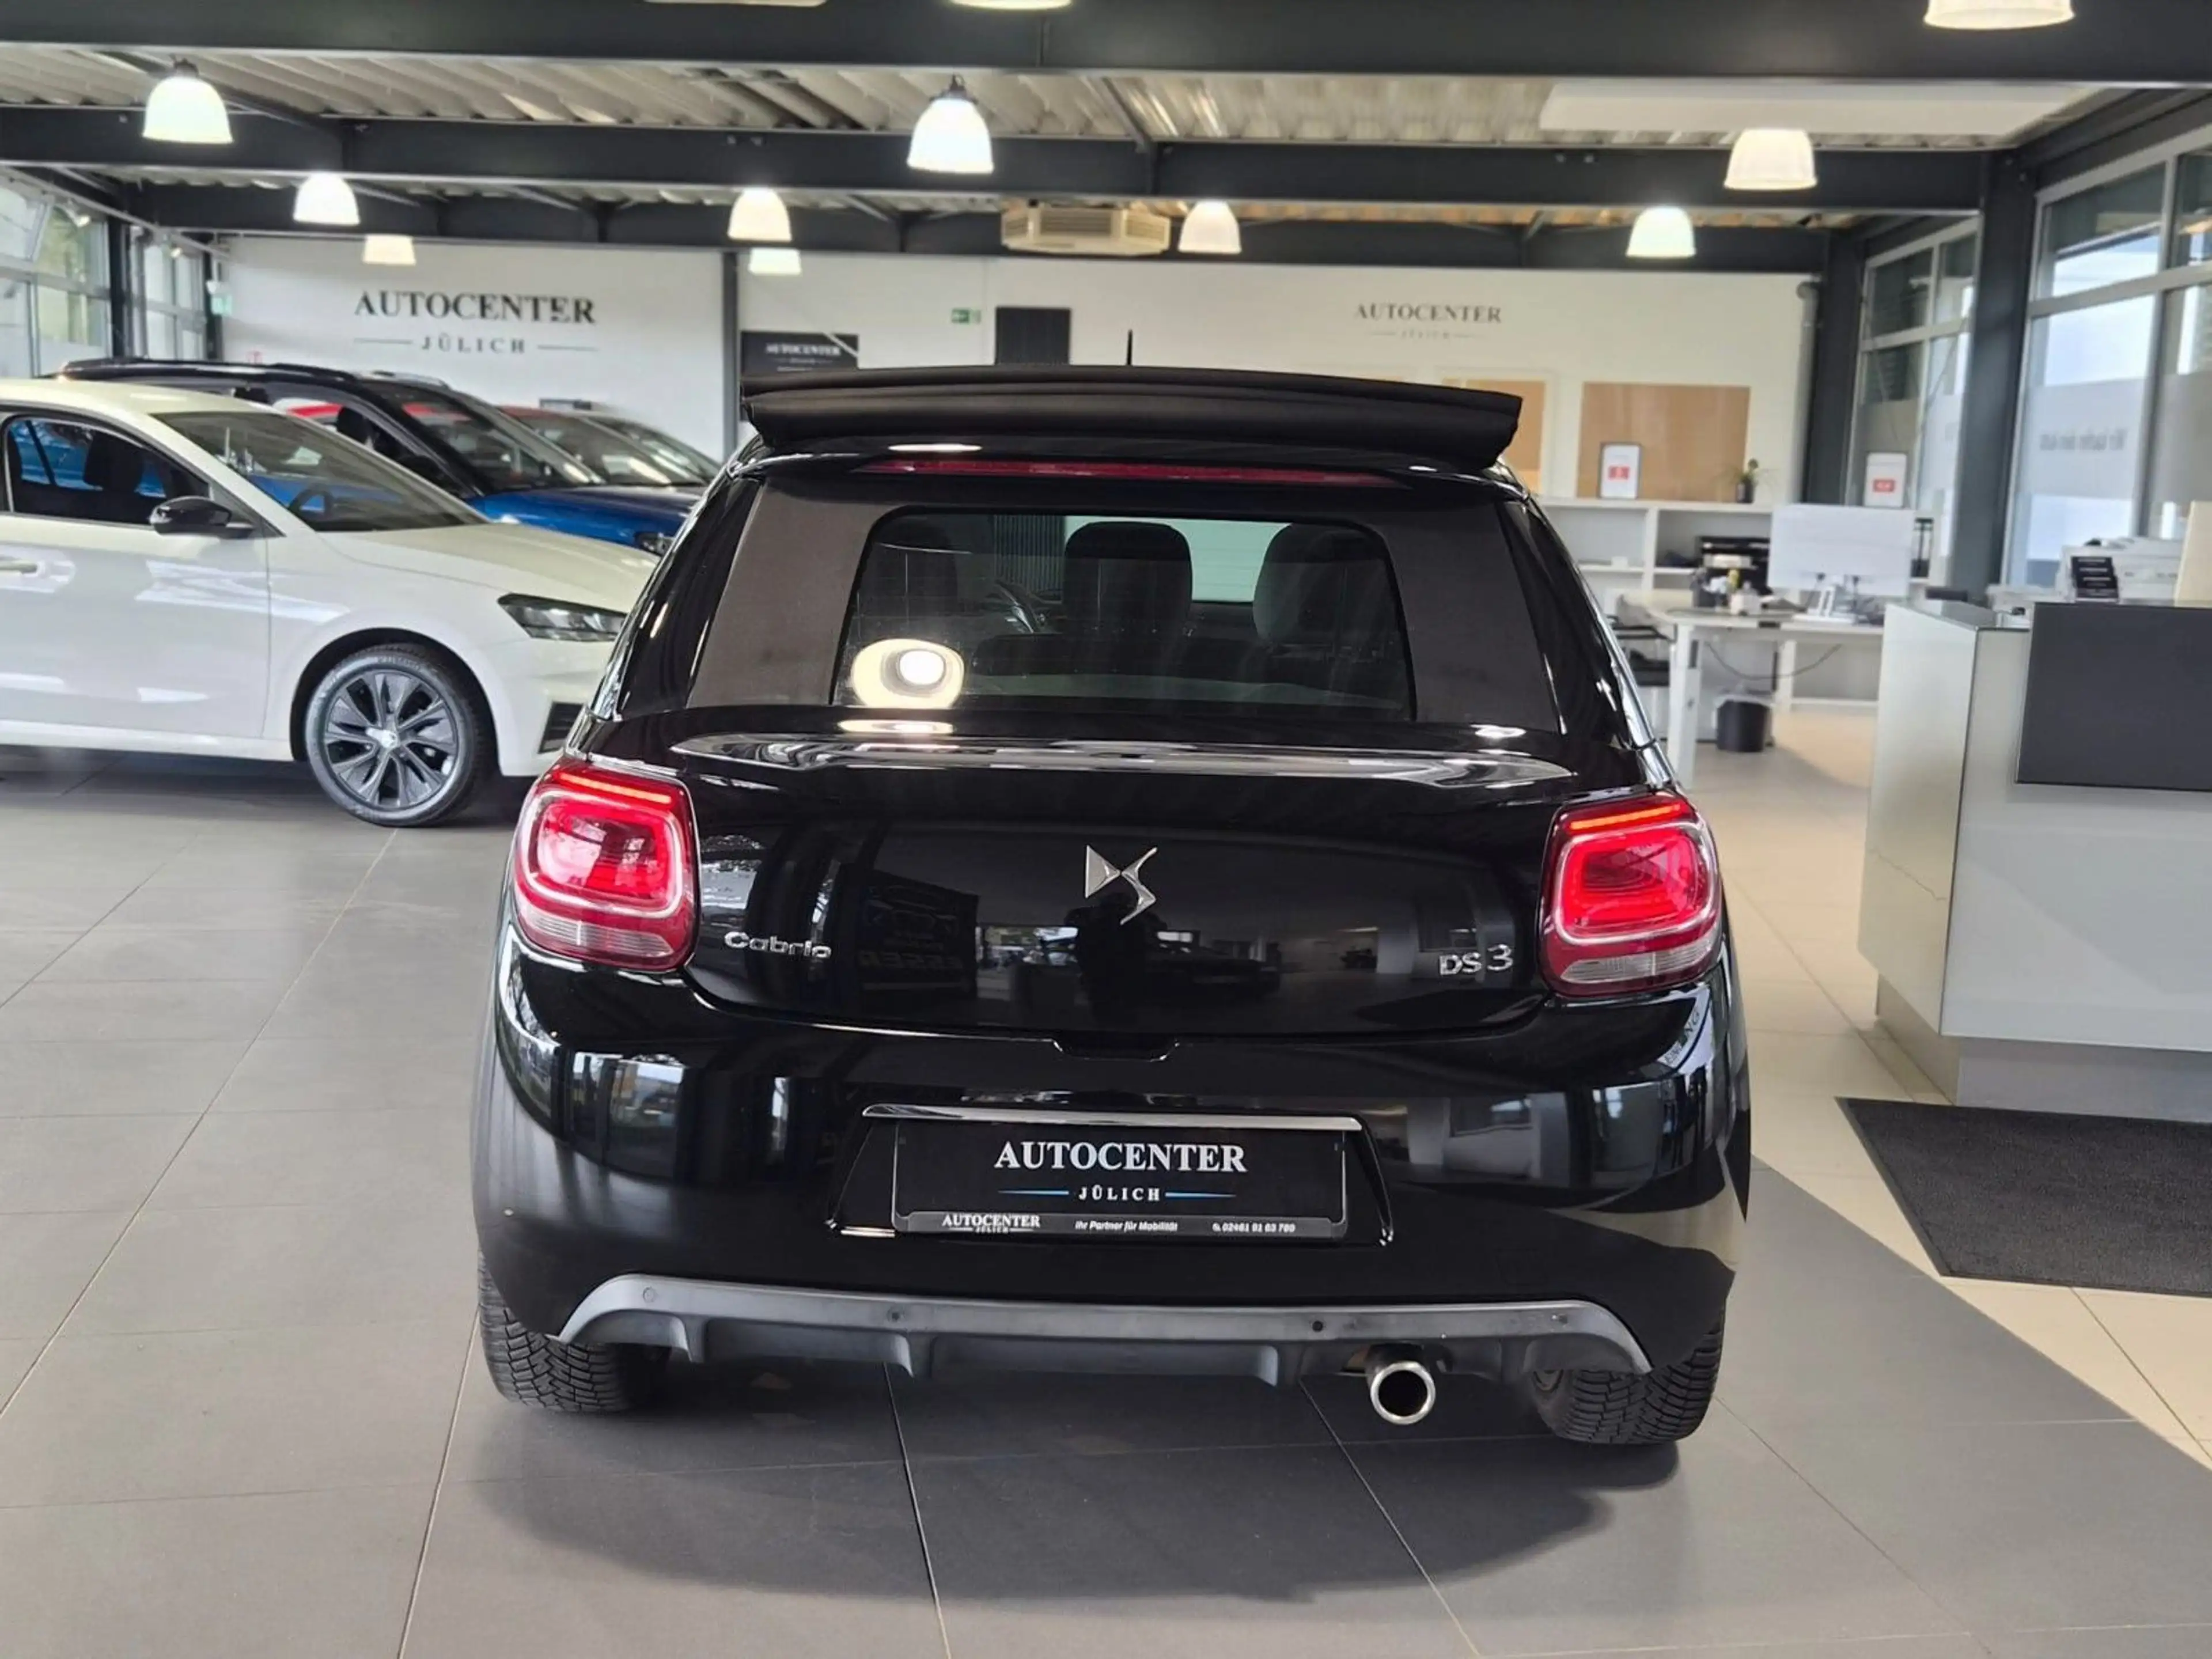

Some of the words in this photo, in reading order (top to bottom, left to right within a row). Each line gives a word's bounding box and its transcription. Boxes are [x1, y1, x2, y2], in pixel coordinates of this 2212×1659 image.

[354, 290, 597, 324] AUTOCENTER
[1356, 303, 1502, 324] AUTOCENTER
[421, 331, 525, 354] JÜLICH
[724, 930, 832, 959] Cabrio
[1439, 952, 1482, 975] DS
[1486, 943, 1514, 971] 3
[994, 1141, 1249, 1172] AUTOCENTER
[1078, 1184, 1160, 1202] JÜLICH
[942, 1214, 1040, 1228] AUTOCENTER
[1075, 1221, 1088, 1230] Ihr
[1089, 1221, 1123, 1230] Partner
[1124, 1221, 1137, 1233] für
